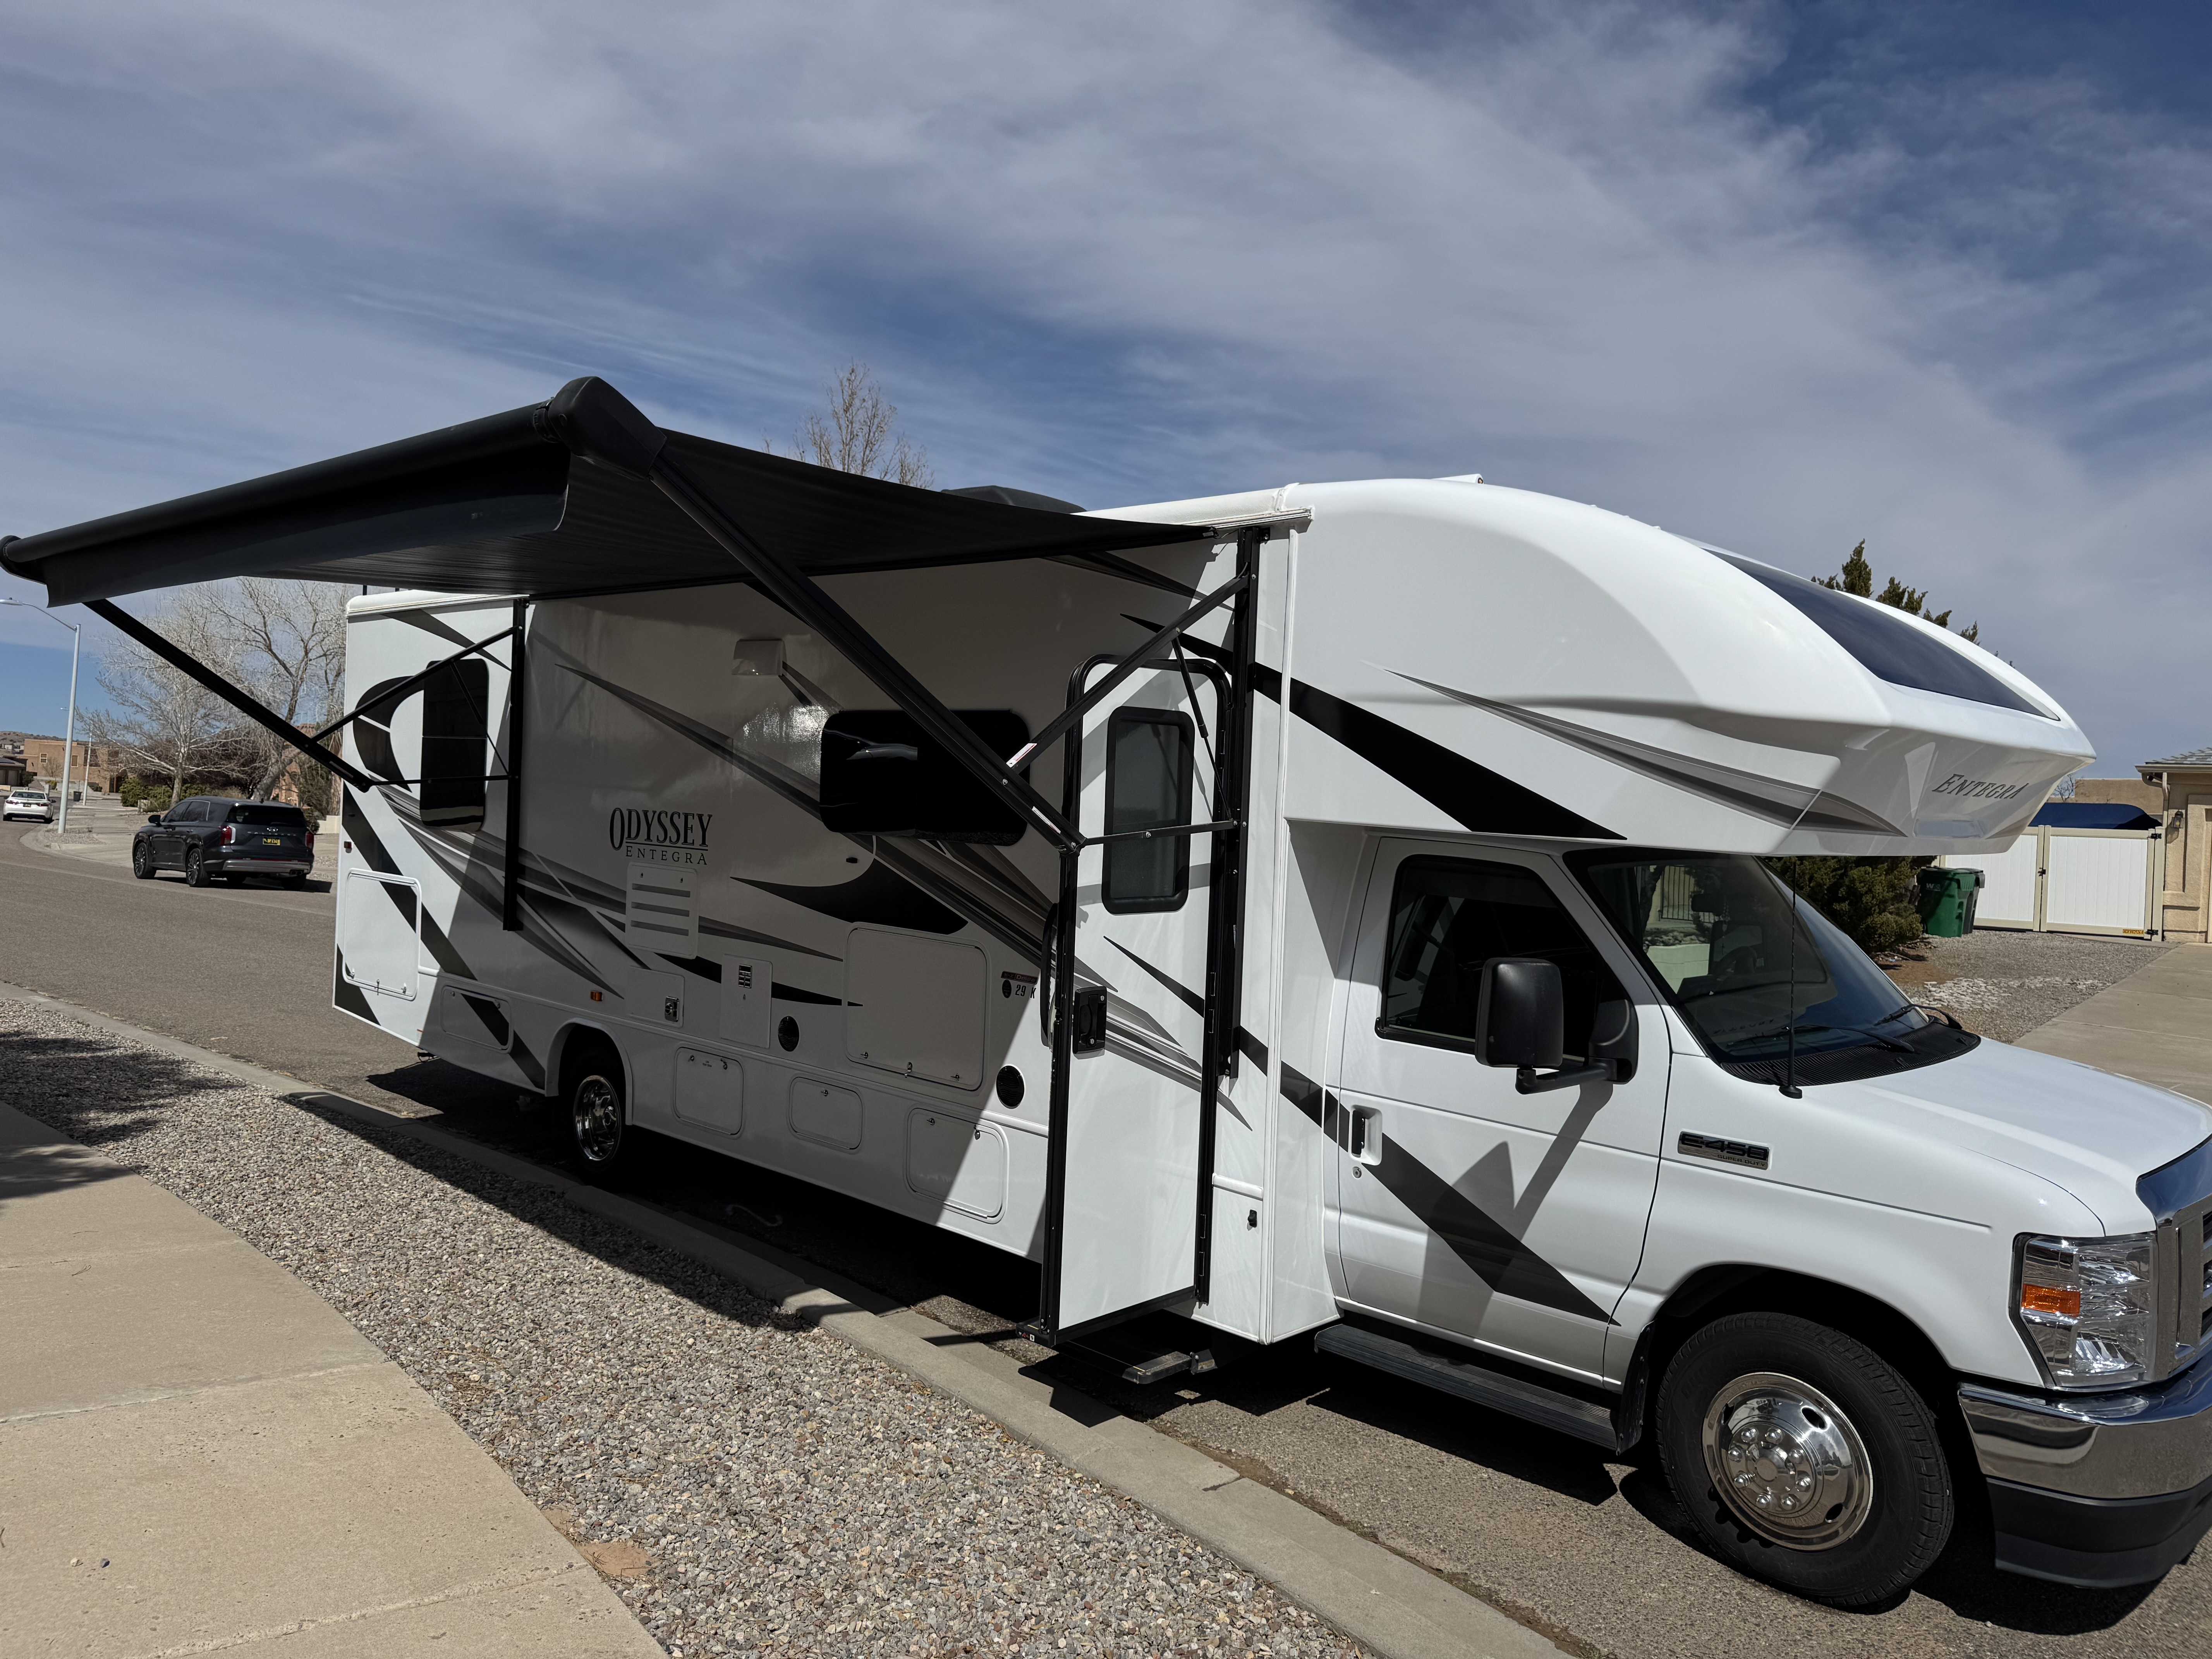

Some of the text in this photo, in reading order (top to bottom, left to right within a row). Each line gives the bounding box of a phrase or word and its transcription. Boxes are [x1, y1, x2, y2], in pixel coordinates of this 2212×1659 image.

[1932, 773, 2029, 799] ENTEGRA
[610, 807, 712, 850] ODYSSEY
[625, 845, 708, 865] ENTEGRA
[1015, 984, 1026, 996] 29
[1681, 1133, 1769, 1161] E-450
[1717, 1154, 1742, 1163] SUPER
